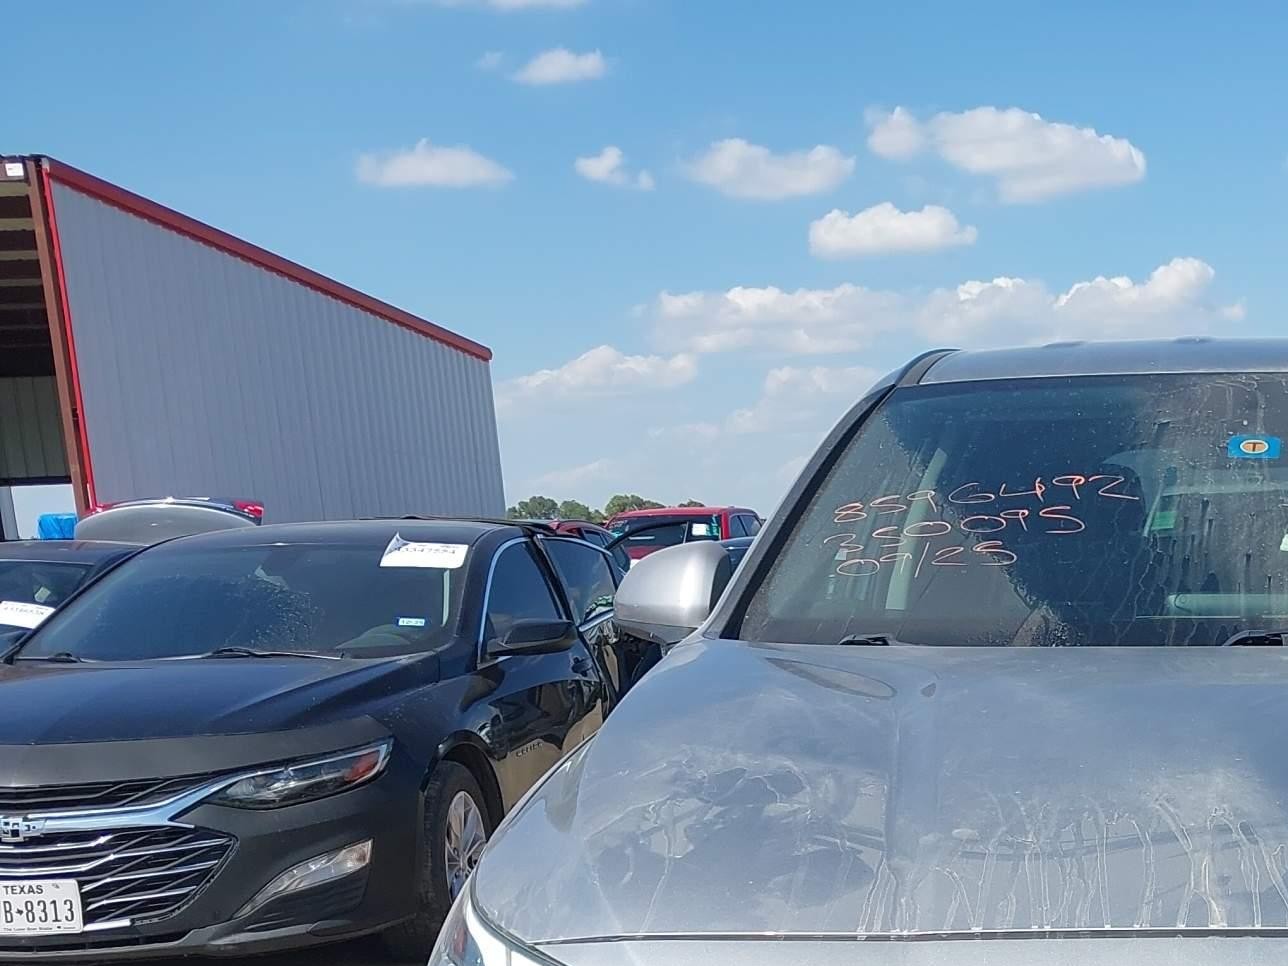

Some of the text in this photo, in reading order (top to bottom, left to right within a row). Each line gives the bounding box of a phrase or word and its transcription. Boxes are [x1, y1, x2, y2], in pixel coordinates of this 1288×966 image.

[824, 505, 1086, 553] 350095
[836, 541, 1017, 577] 09/25
[2, 884, 44, 896] TEXAS
